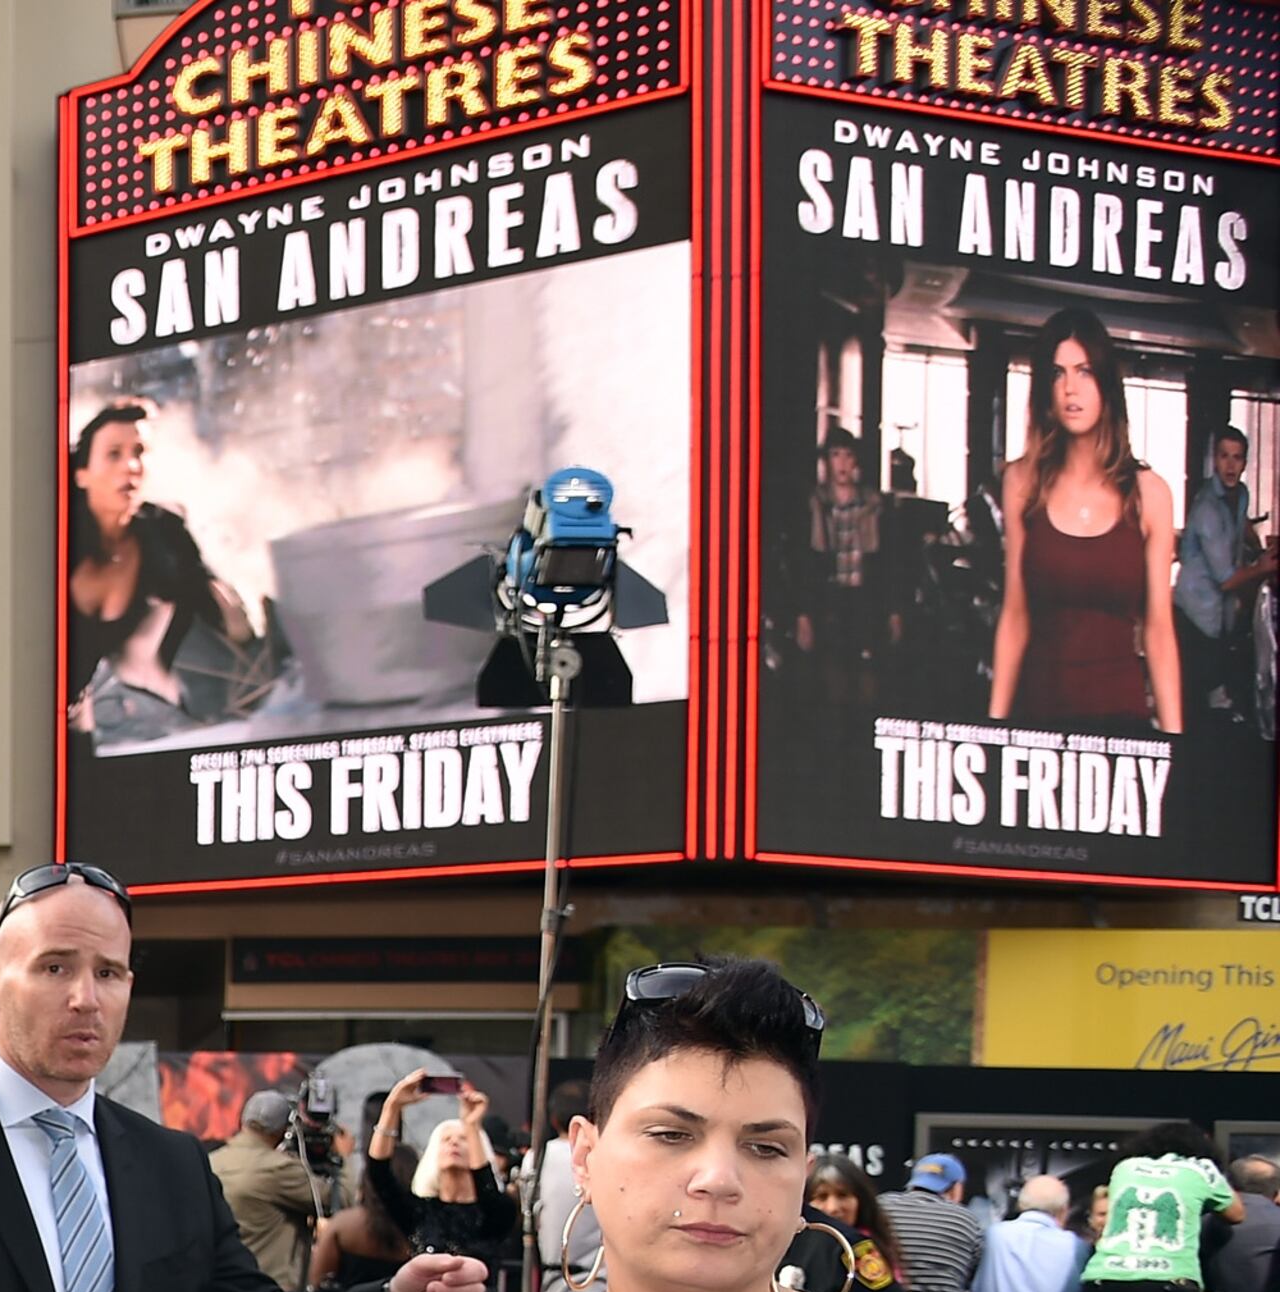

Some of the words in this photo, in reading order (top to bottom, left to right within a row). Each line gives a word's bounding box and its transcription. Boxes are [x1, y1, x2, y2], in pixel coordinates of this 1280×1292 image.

[139, 34, 595, 193] THEATRES
[842, 12, 1236, 131] THEATRES
[145, 194, 325, 257] DWAYNE
[348, 134, 592, 211] JOHNSON
[834, 119, 1001, 167] DWAYNE
[1022, 149, 1215, 197] JOHNSON
[109, 245, 241, 346] SAN
[277, 159, 639, 312] ANDREAS
[797, 149, 924, 247] SAN
[957, 173, 1247, 291] ANDREAS
[190, 762, 313, 846] THIS
[329, 740, 543, 837] FRIDAY
[874, 736, 986, 826] THIS
[1001, 745, 1171, 838] FRIDAY
[275, 841, 437, 866] #SANANDREAS
[1240, 894, 1280, 921] TCL
[1095, 962, 1213, 992] Opening
[1220, 963, 1275, 988] This
